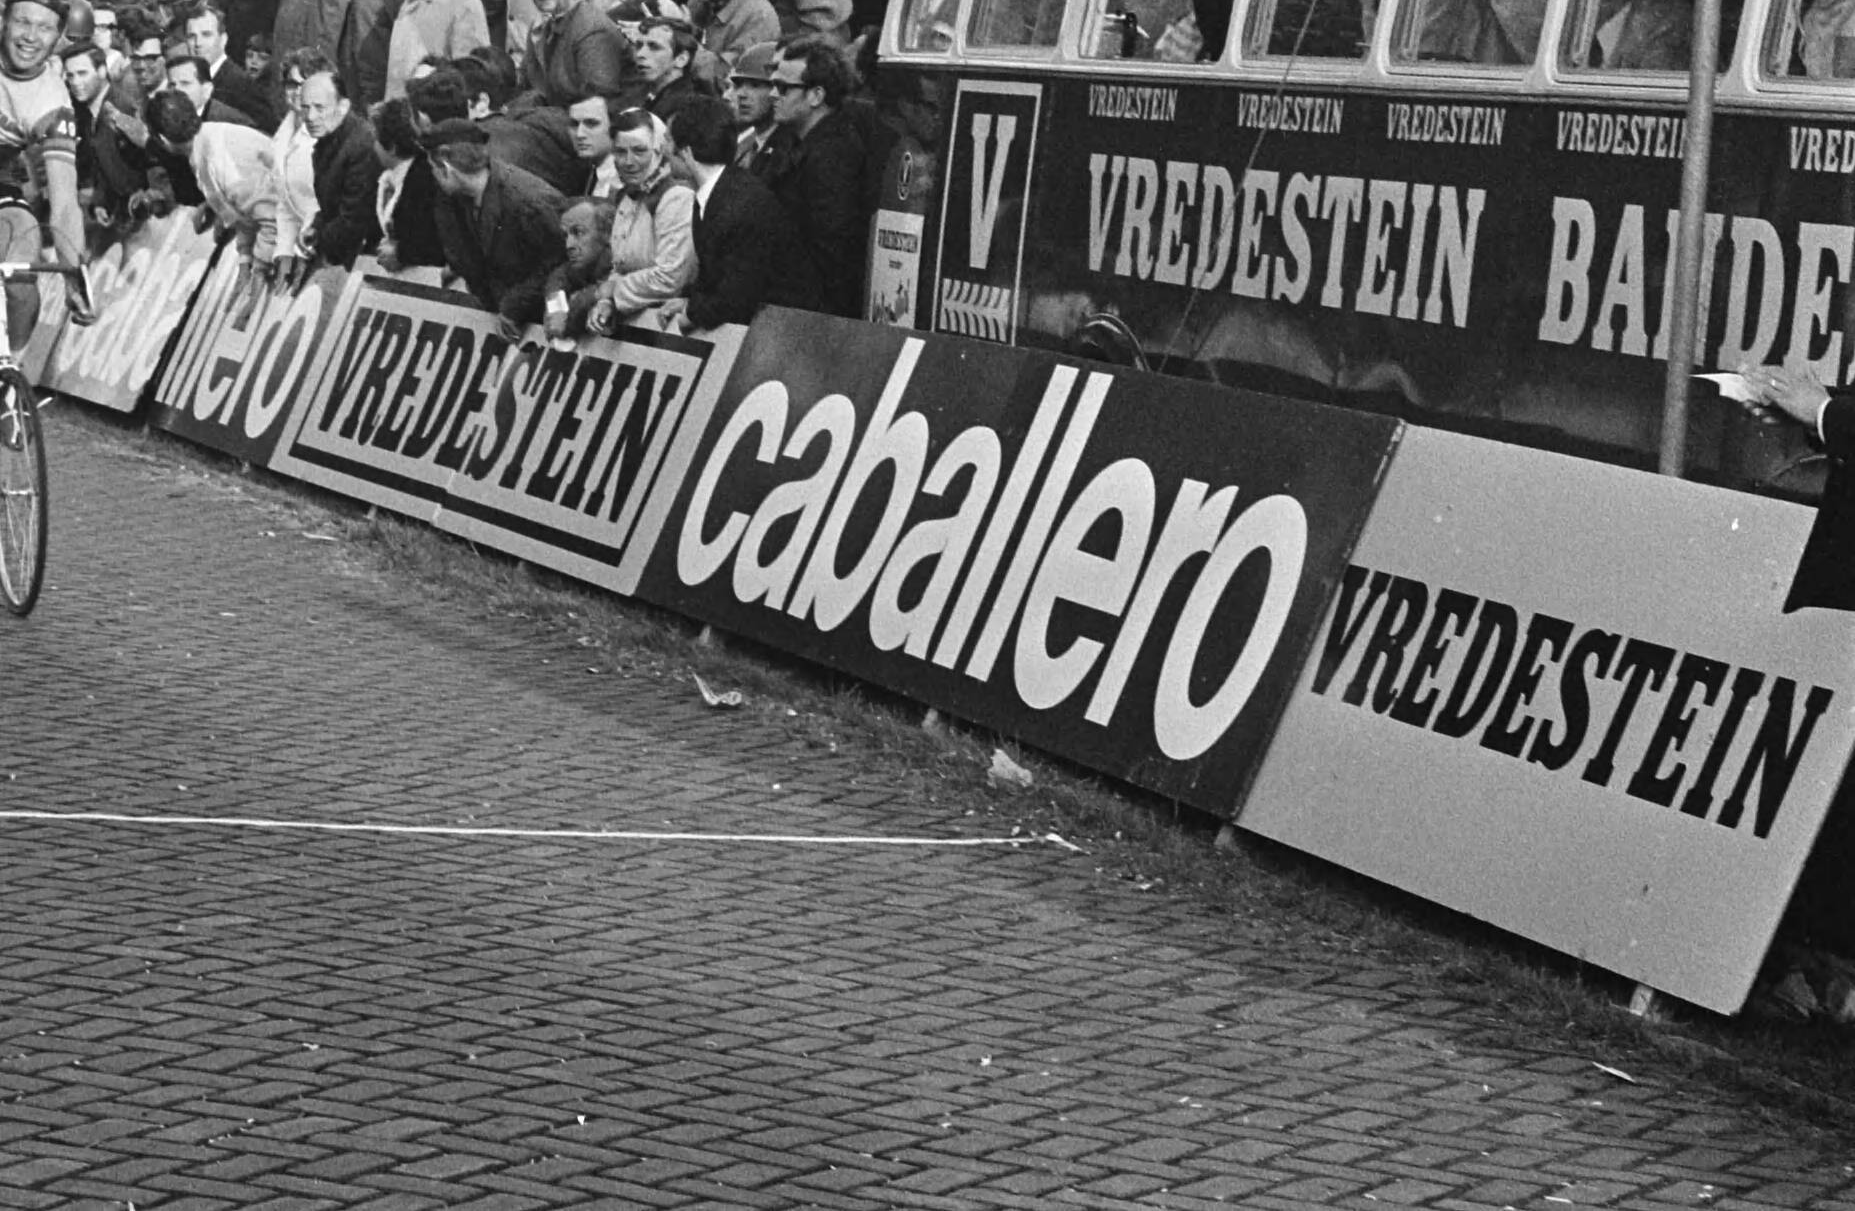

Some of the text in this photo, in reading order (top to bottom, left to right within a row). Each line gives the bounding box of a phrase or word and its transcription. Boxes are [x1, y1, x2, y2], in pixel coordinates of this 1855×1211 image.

[968, 113, 1017, 270] V
[1088, 83, 1179, 121] VREDESTEIN
[1237, 92, 1344, 134] VREDESTEIN
[1386, 102, 1506, 145] VREDESTEIN
[1087, 153, 1855, 387] VREDESTEIN BANDE
[318, 305, 683, 523] VREDESTEIN
[677, 337, 1308, 761] caballero
[1310, 565, 1834, 840] VREDESTEIN
